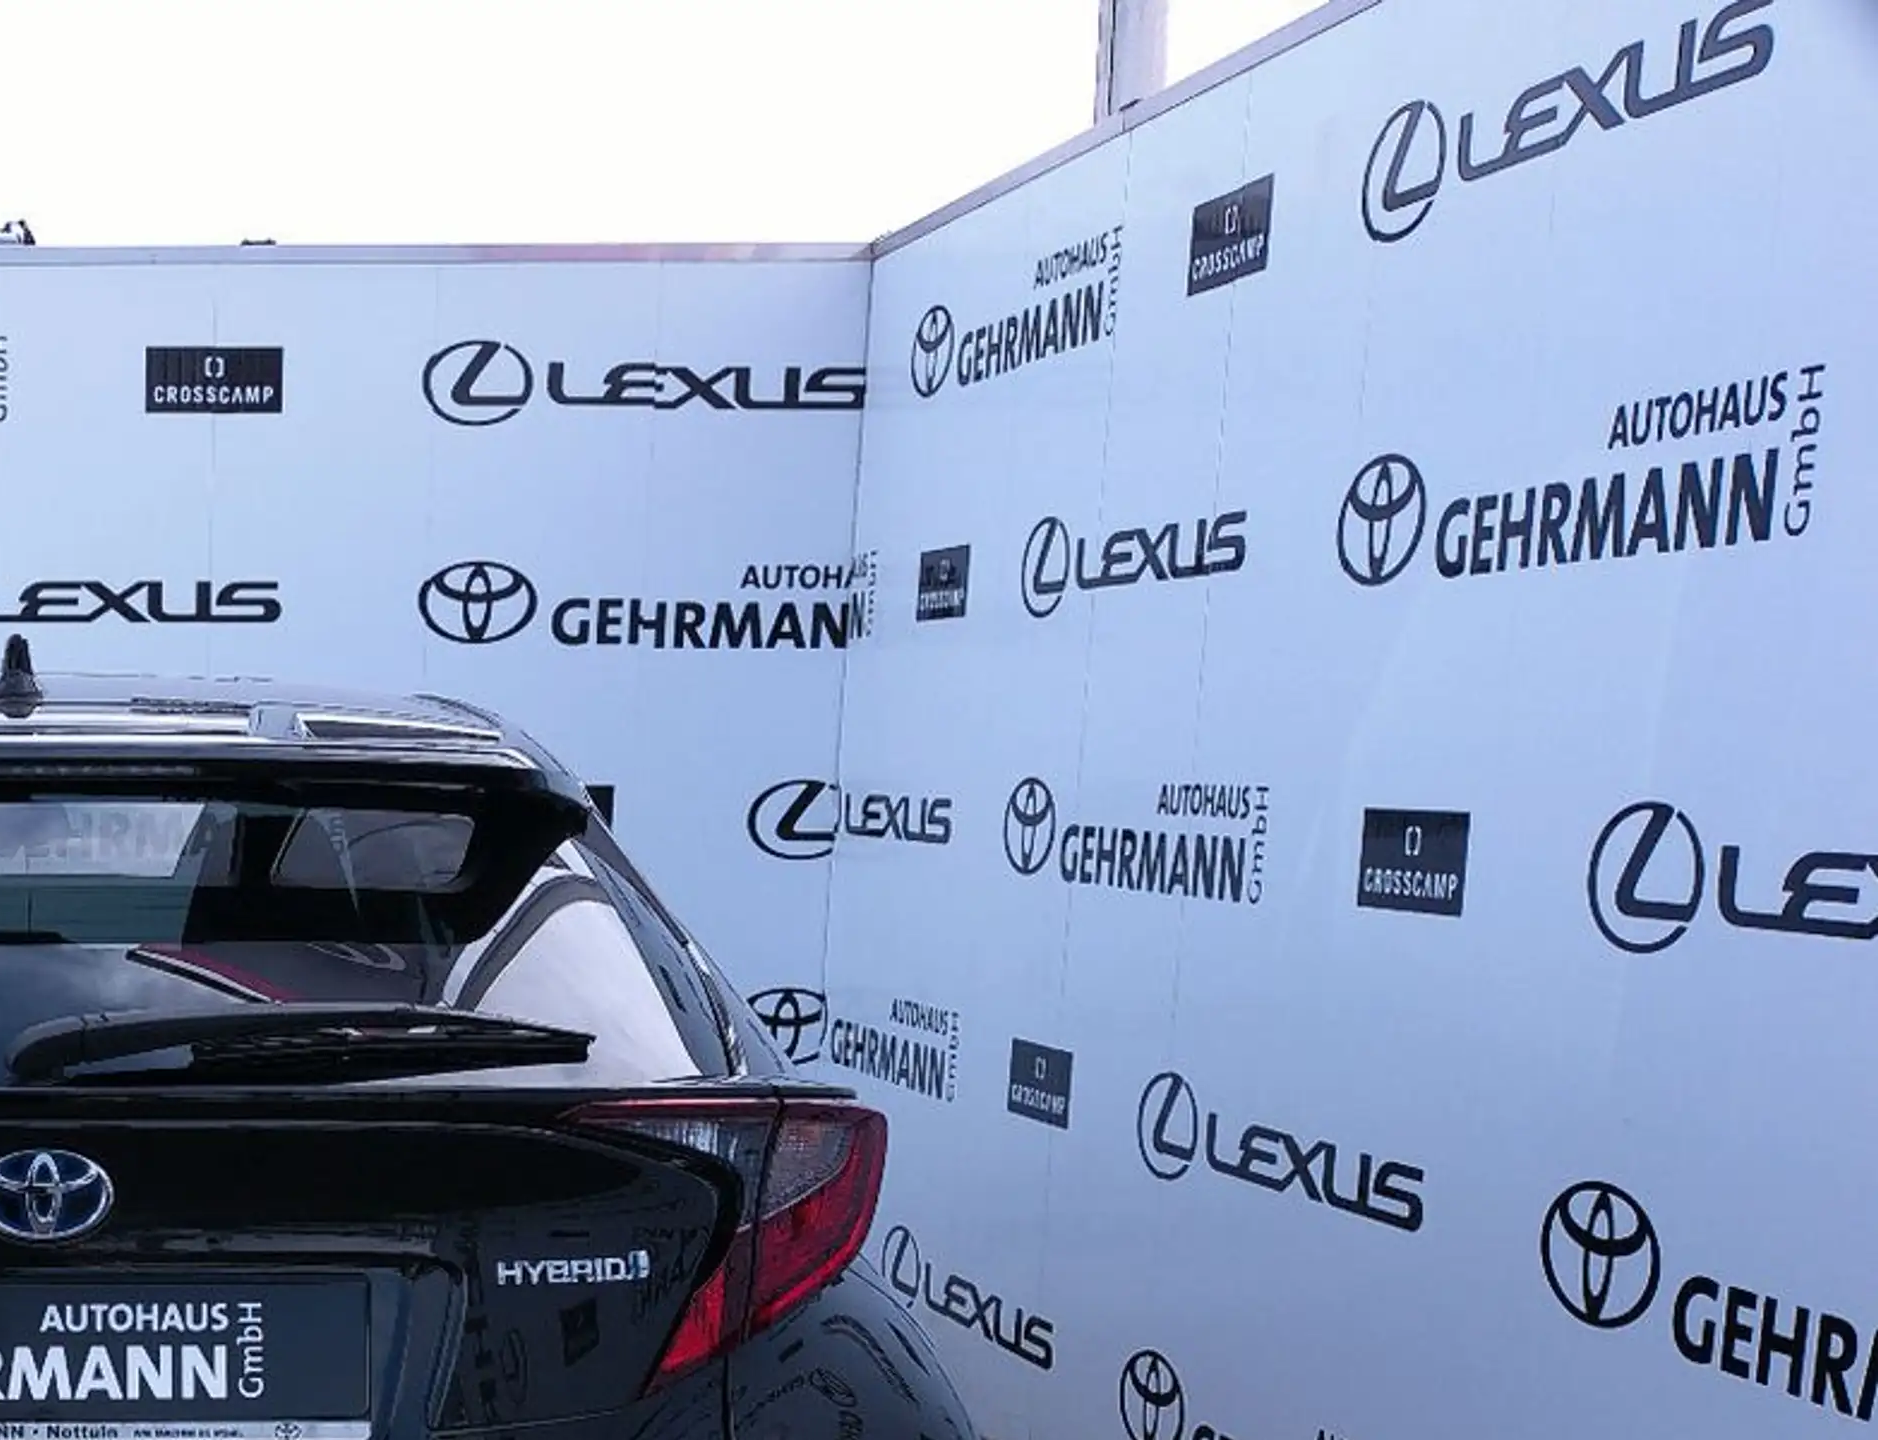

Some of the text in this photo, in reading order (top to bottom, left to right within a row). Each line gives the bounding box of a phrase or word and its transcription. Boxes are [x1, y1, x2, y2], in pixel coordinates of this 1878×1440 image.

[1458, 0, 1774, 182] LEXUS
[1034, 232, 1108, 289] AUTOHAUS
[957, 278, 1103, 387] GEHRMANN
[154, 386, 273, 404] CROSSCAMP
[547, 362, 867, 410] LEXUS
[1608, 371, 1787, 449] AUTOHAUS
[1784, 364, 1825, 536] GmbH
[1076, 511, 1246, 590] LEXUS
[1436, 448, 1779, 578] GEHRMANN
[551, 590, 866, 650] GEHRMANN
[842, 793, 952, 846] LEXUS
[1157, 784, 1250, 819] AUTOHAUS
[1060, 824, 1245, 902] GEHRMANN
[1364, 867, 1458, 899] CROSSCAMP
[830, 1020, 946, 1100] GEHRMANN
[1207, 1113, 1423, 1232] LEXUS
[497, 1256, 630, 1286] HYBRID
[40, 1303, 228, 1332] AUTOHAUS
[237, 1303, 263, 1398] GmbH
[921, 1263, 1053, 1370] LEXUS
